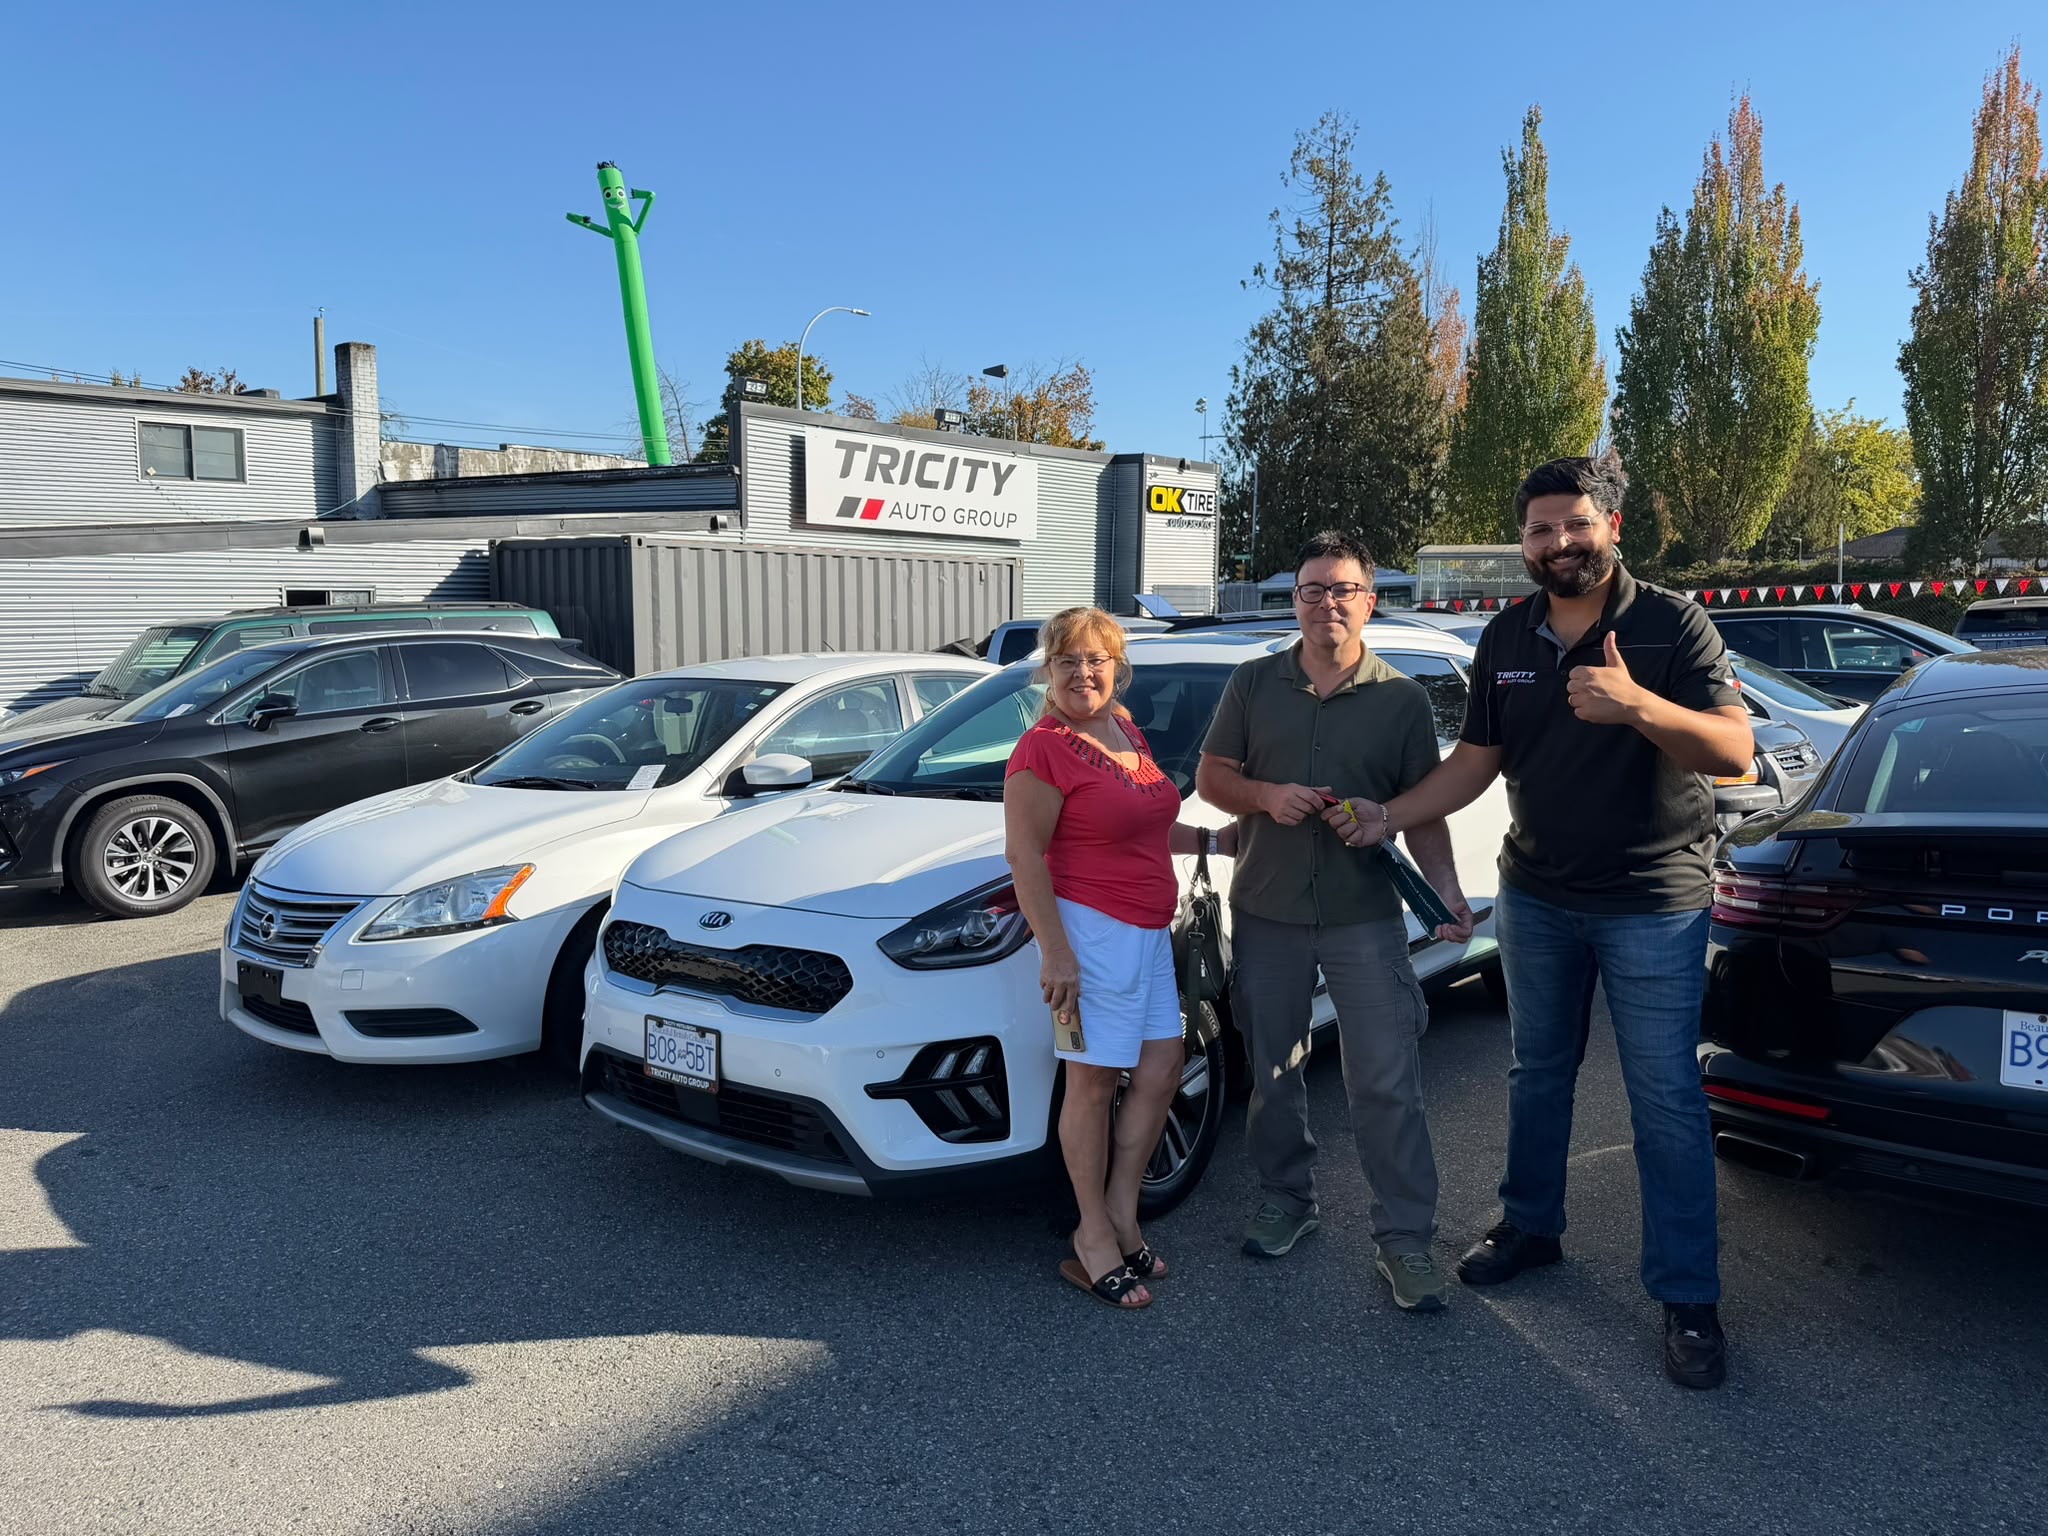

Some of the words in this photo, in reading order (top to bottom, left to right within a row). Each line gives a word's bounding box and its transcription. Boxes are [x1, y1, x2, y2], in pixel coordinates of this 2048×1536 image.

[834, 439, 1018, 496] TRICITY
[1151, 486, 1183, 513] OK
[1187, 493, 1213, 512] TIRE
[888, 502, 946, 523] AUTO
[953, 508, 1018, 529] GROUP
[1496, 671, 1536, 679] TRICITY
[701, 912, 727, 926] KIA
[648, 1033, 677, 1065] B08
[686, 1041, 715, 1075] 5BT
[651, 1067, 672, 1080] TRICITY
[671, 1073, 688, 1084] AUTO
[688, 1077, 710, 1090] GROUP
